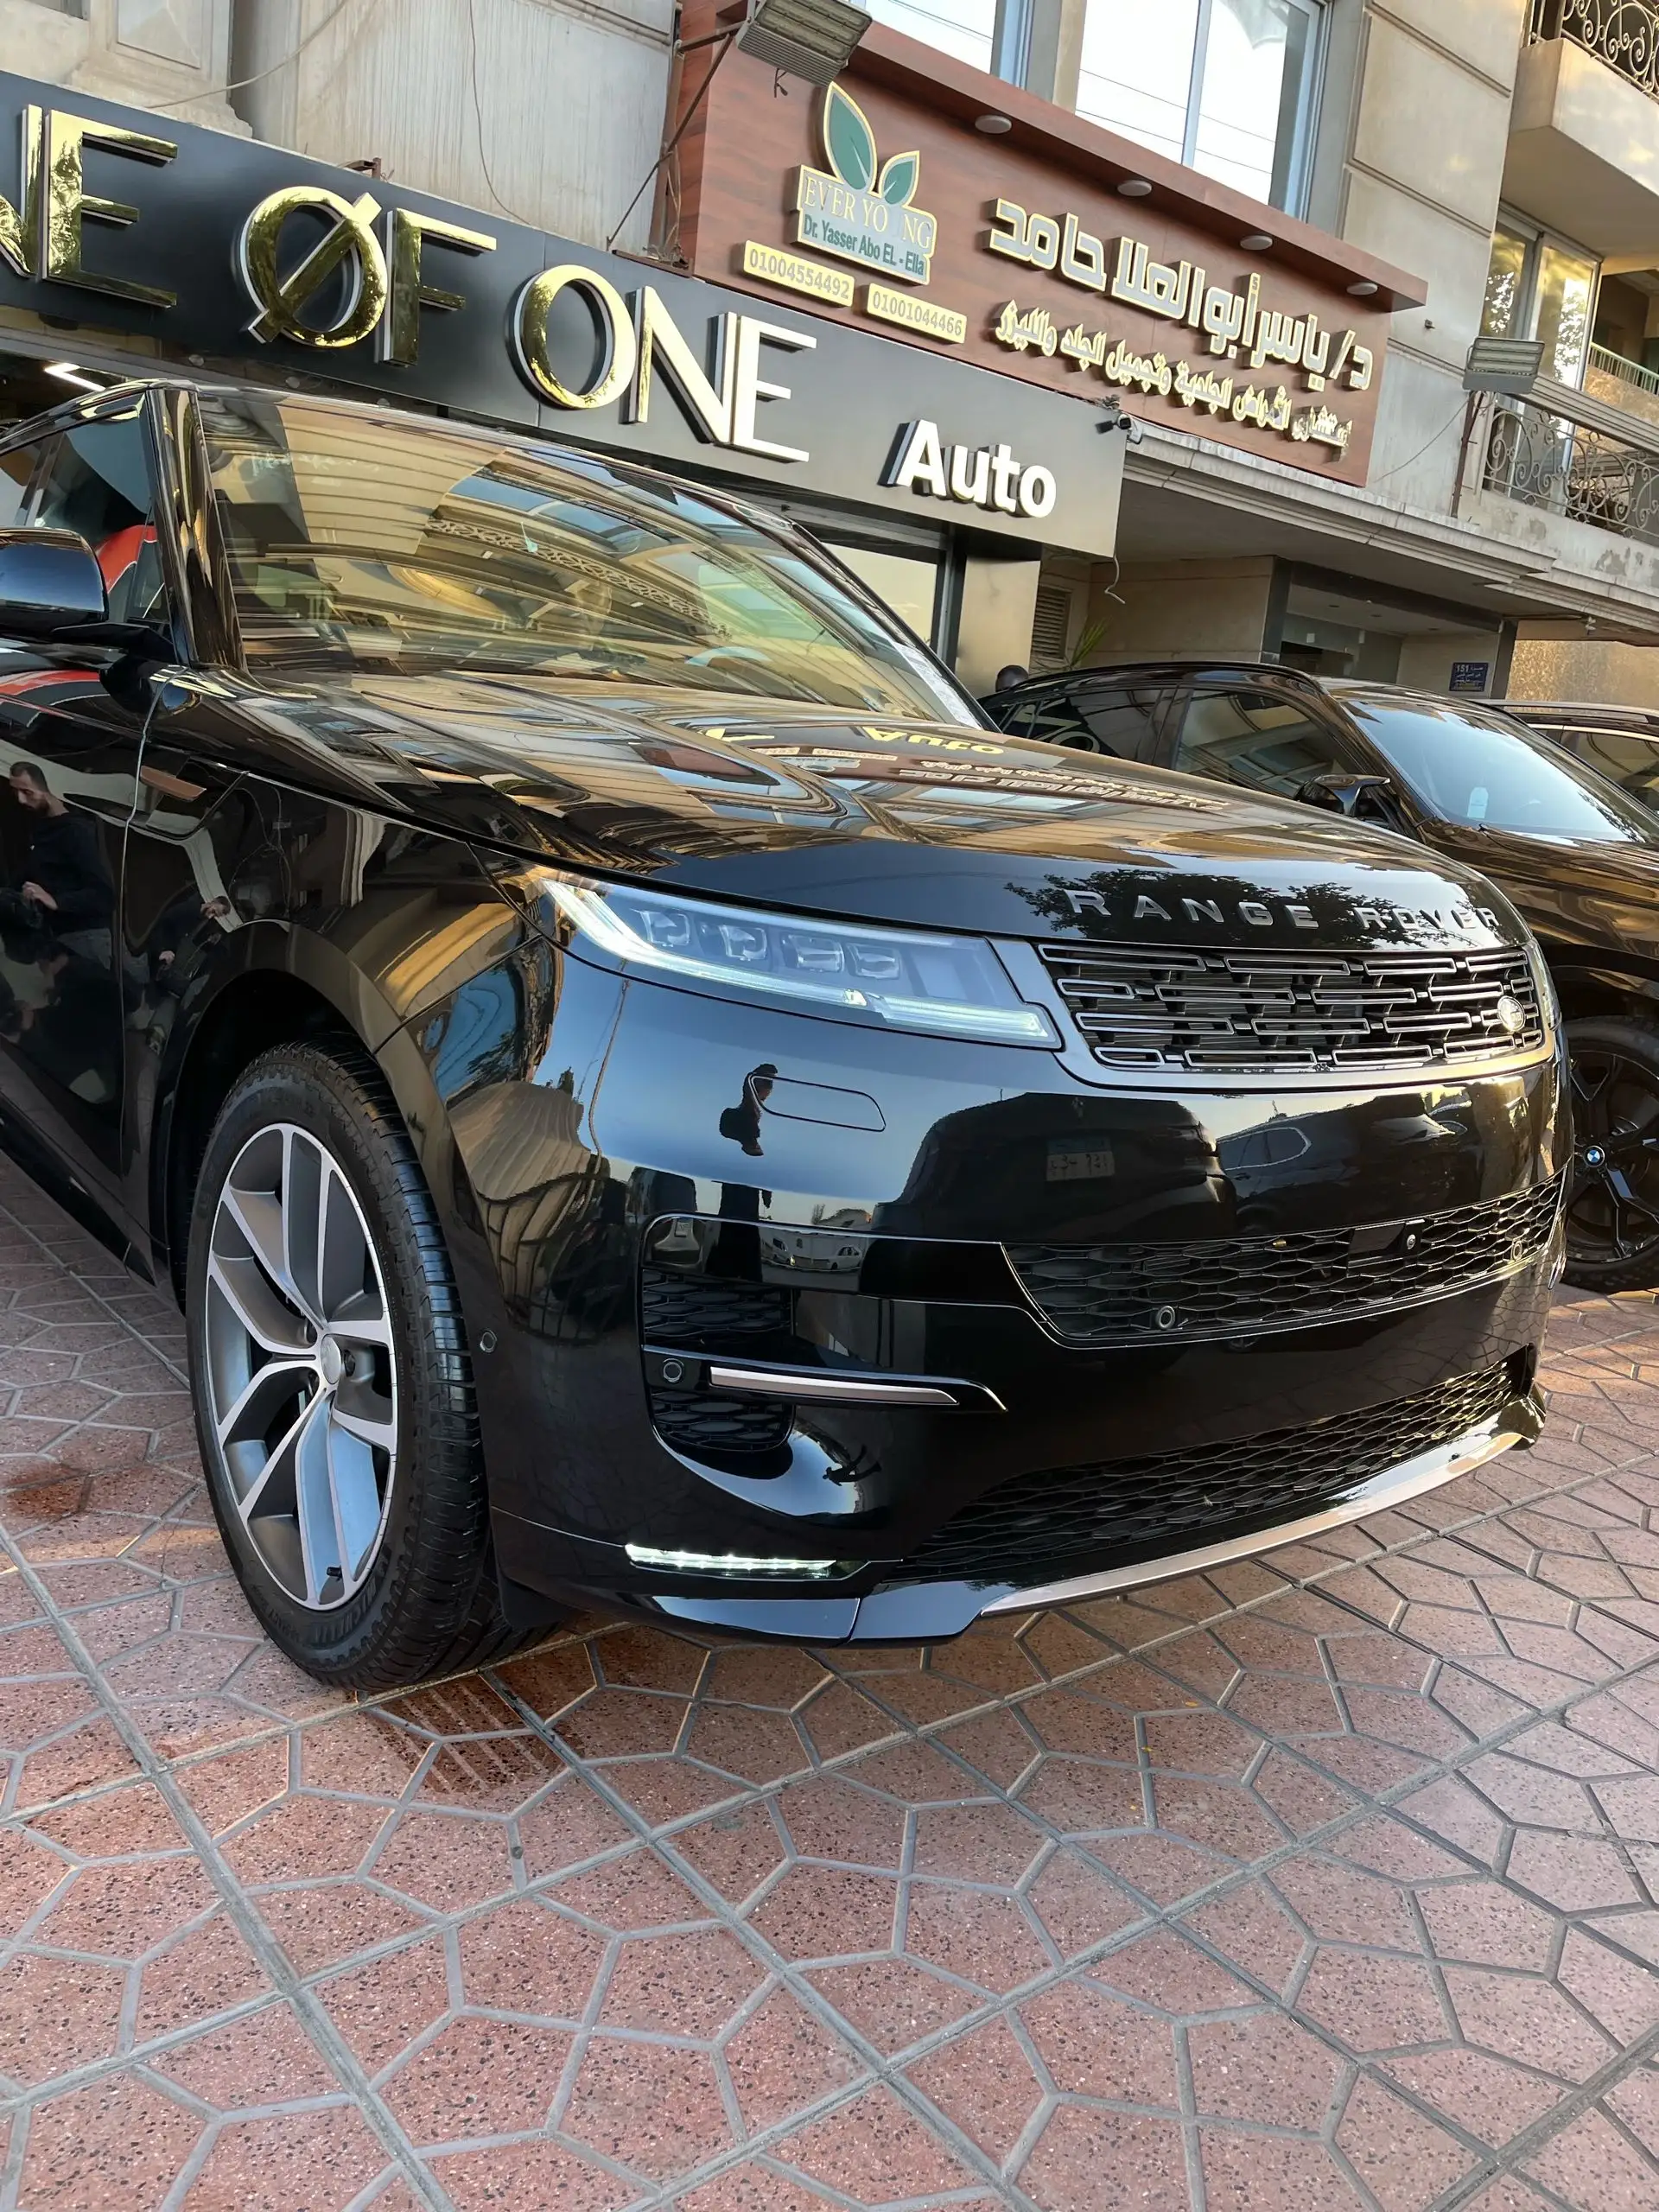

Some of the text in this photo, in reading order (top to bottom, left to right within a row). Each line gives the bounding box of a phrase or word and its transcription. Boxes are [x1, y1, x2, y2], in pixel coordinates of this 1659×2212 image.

[804, 175, 857, 224] EVER
[803, 213, 818, 238] Dr.
[822, 219, 858, 251] Yasser
[858, 233, 881, 260] Abo
[882, 242, 897, 266] EL
[905, 251, 925, 276] Ella
[988, 197, 1107, 292] حامد
[749, 248, 850, 300] 01004554492
[872, 290, 963, 336] 01001044466
[1059, 323, 1108, 372] الجلد
[1249, 313, 1331, 392] ياسر
[515, 264, 817, 463] ONE
[885, 419, 1057, 518] Auto
[1173, 359, 1234, 415] الجلدية
[1456, 664, 1470, 672] 151
[1061, 889, 1501, 931] RANGE ROVER
